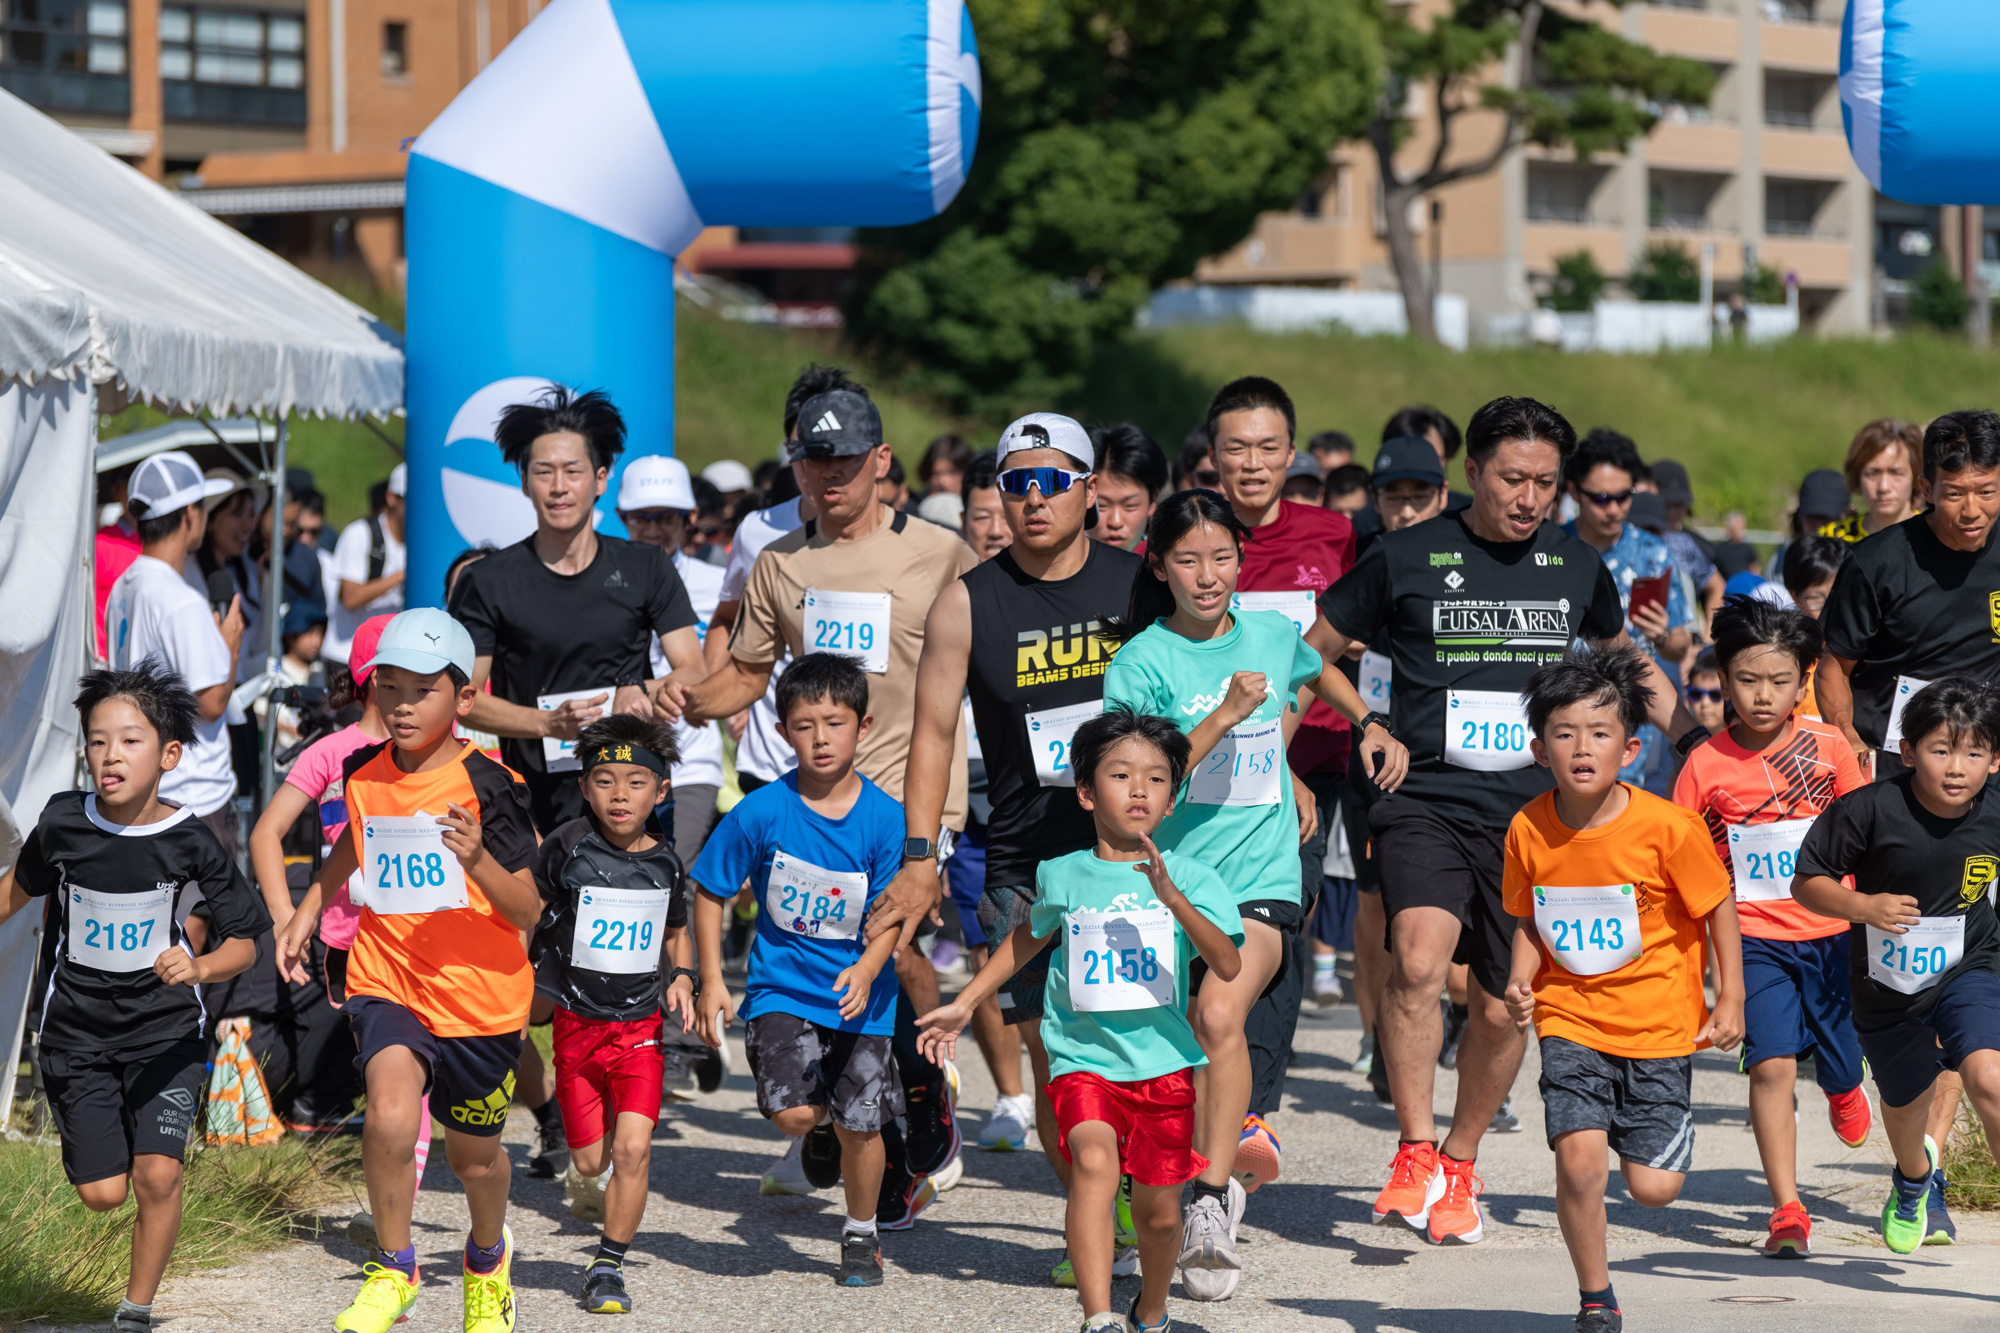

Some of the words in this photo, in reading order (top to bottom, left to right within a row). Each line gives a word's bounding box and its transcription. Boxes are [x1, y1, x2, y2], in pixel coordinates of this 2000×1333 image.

[814, 619, 874, 651] 2219
[1433, 608, 1503, 631] FUTSAL
[1506, 608, 1570, 631] ARENA
[1436, 651, 1445, 663] El
[1447, 651, 1480, 667] pueblo
[1482, 651, 1513, 662] donde
[1537, 653, 1544, 666] y
[1016, 667, 1070, 688] BEAMS
[1461, 720, 1526, 752] 2180
[1207, 748, 1275, 777] 2158
[377, 852, 446, 888] 2168
[780, 885, 847, 922] 2184
[84, 918, 156, 952] 2187
[589, 918, 653, 951] 2219
[1104, 922, 1135, 930] RIVERSIDE
[1551, 917, 1624, 952] 2143
[1083, 946, 1159, 985] 2158
[1881, 938, 1947, 975] 2150
[163, 1108, 178, 1118] OUR
[164, 1116, 179, 1125] OUR
